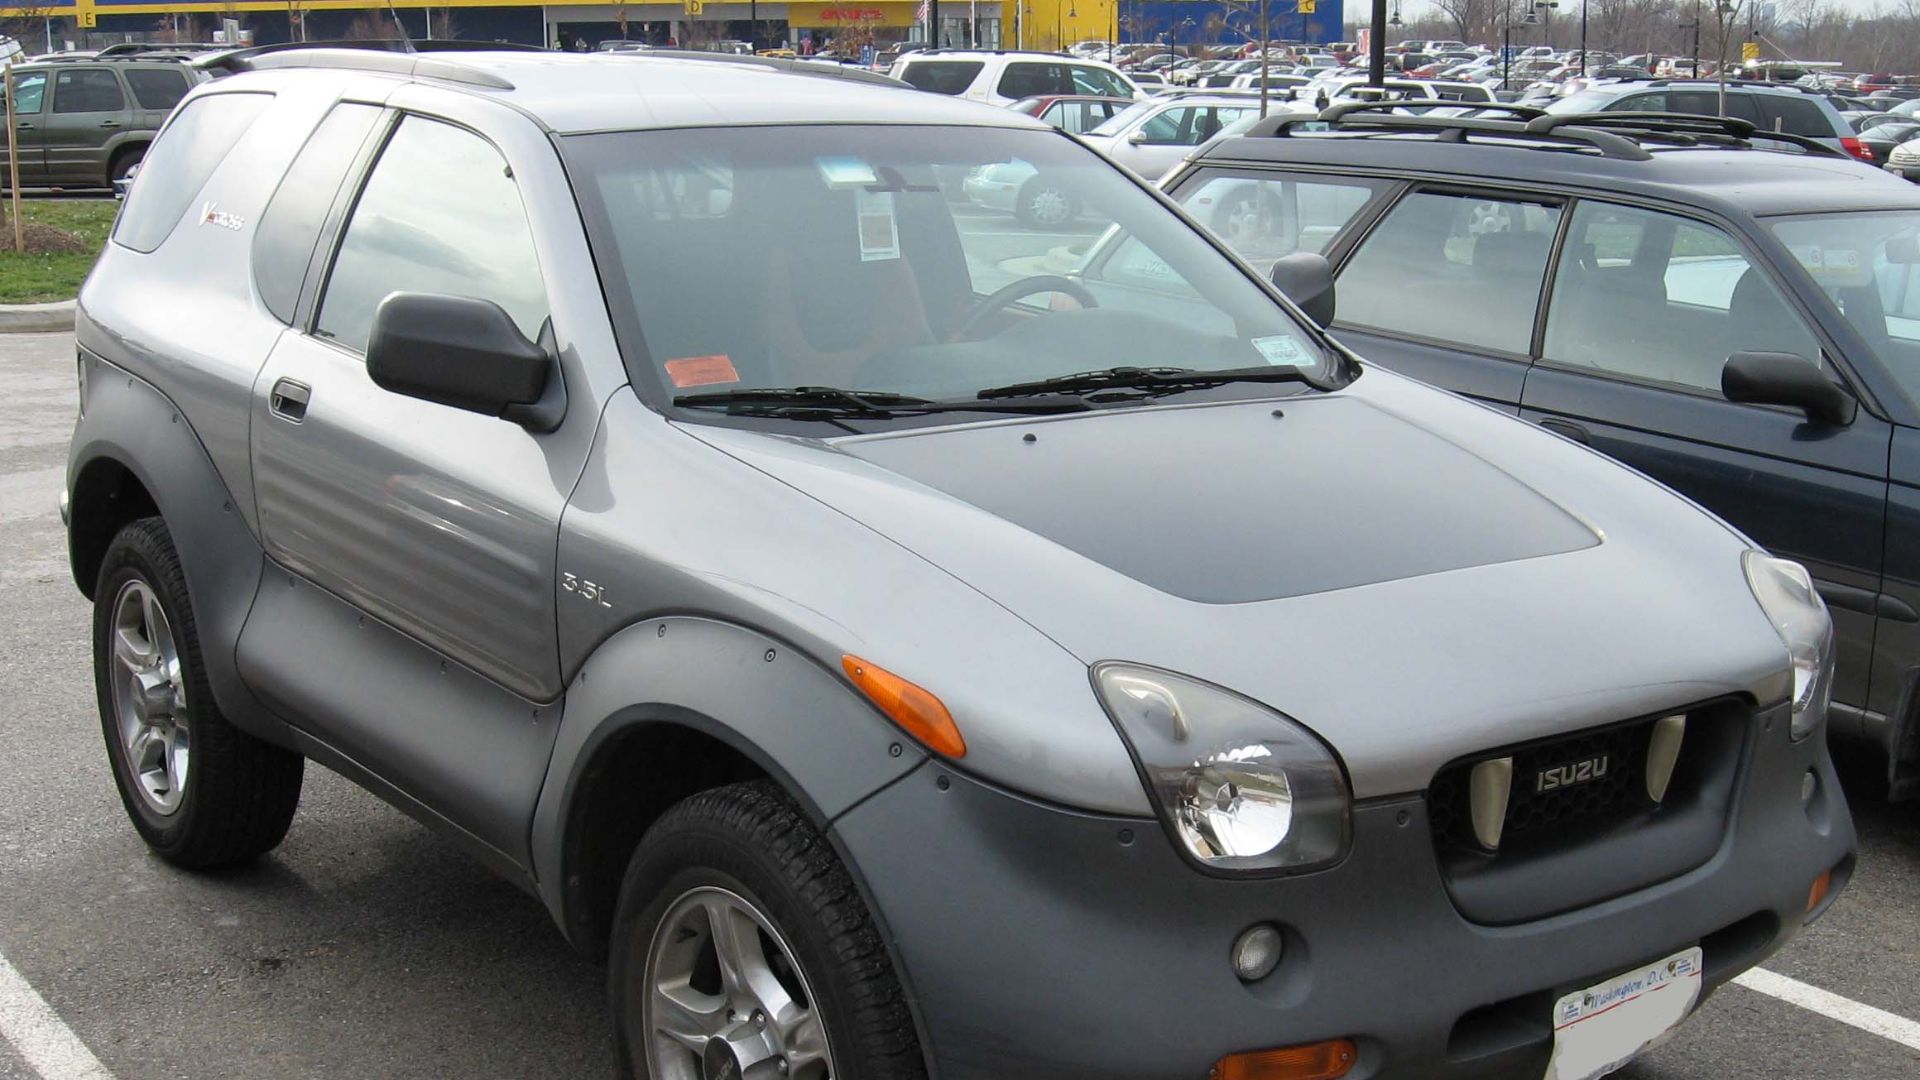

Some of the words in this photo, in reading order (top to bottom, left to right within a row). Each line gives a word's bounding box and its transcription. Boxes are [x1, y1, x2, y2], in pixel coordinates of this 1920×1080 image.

[85, 12, 92, 26] E
[690, 0, 700, 13] D
[562, 572, 612, 608] 3.5L
[1537, 756, 1608, 792] ISUZU
